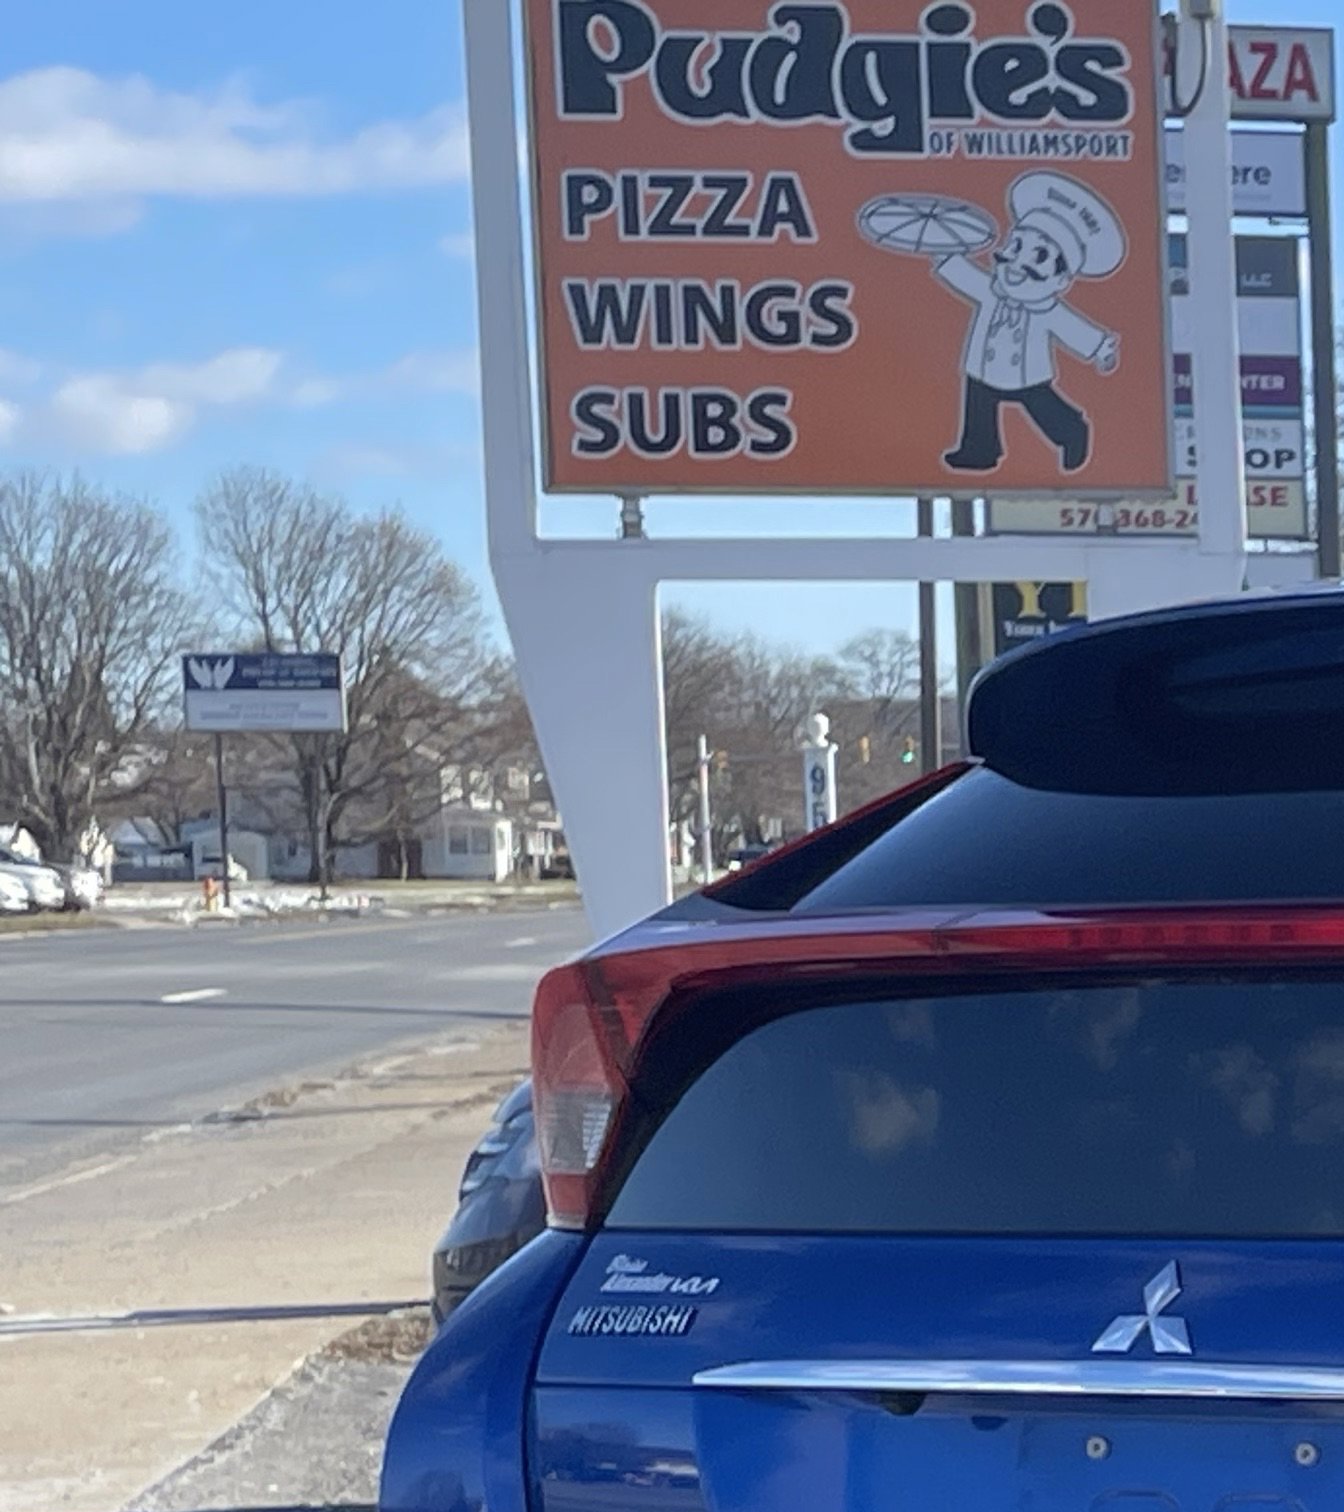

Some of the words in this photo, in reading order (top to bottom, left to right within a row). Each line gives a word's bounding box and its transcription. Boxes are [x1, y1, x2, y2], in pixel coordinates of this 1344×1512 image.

[557, 1, 1131, 154] Pudgie's
[929, 132, 954, 155] OF
[964, 132, 1130, 157] WILLIAMSPORT
[565, 173, 814, 238] PIZZA
[567, 282, 855, 348] WINGS
[574, 392, 794, 454] SUBS
[567, 1304, 695, 1335] MITSUBISHI
